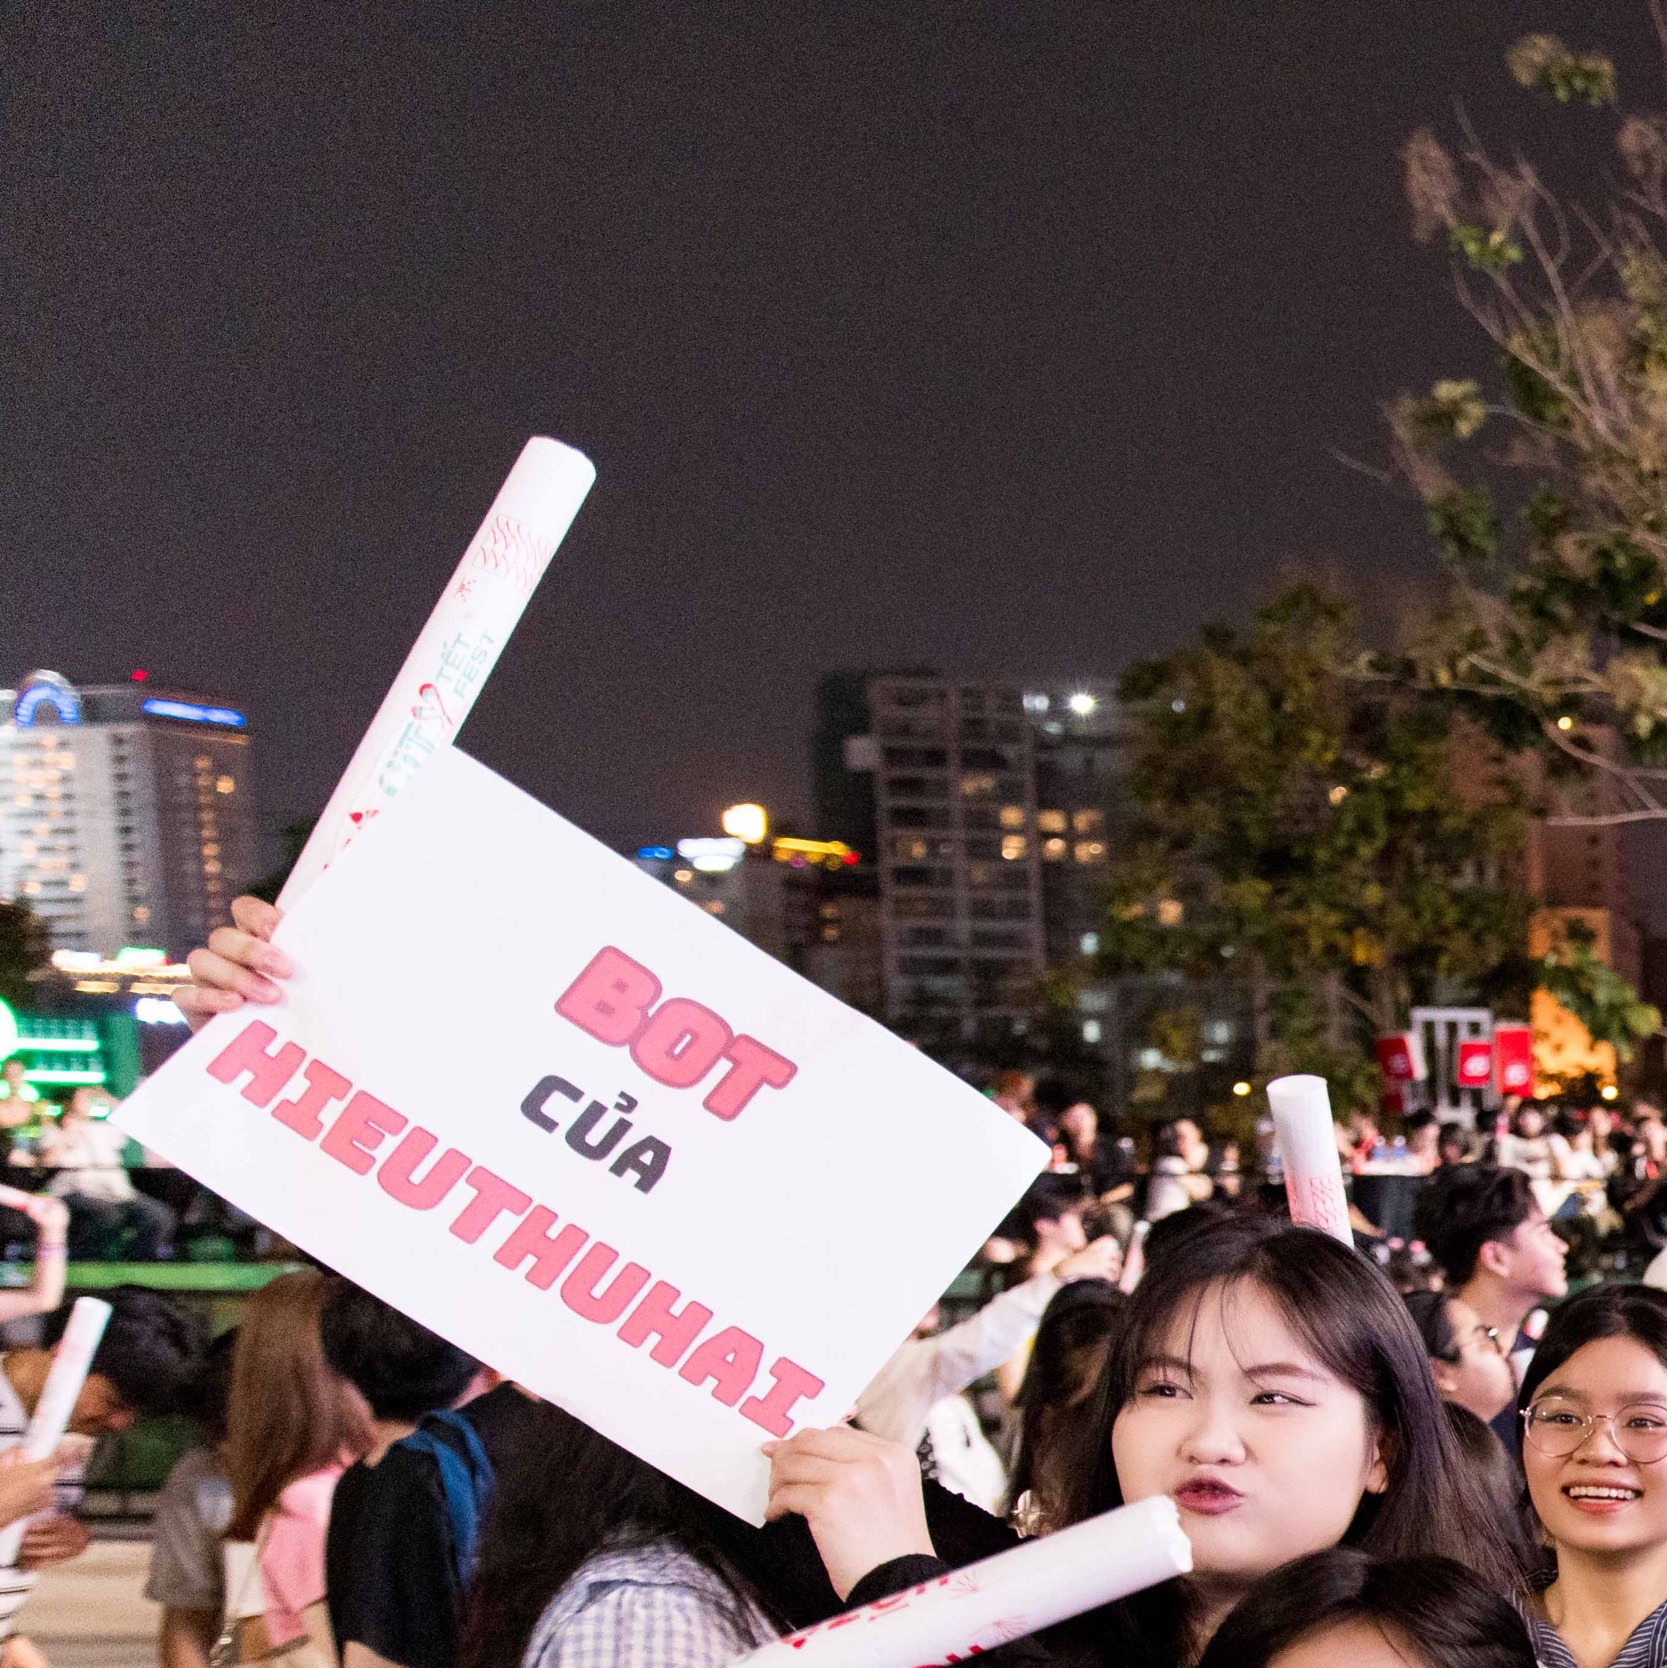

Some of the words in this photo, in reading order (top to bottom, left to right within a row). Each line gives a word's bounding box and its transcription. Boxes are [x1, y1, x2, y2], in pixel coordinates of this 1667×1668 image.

[434, 630, 472, 684] TẾT
[452, 628, 496, 700] FEST
[554, 945, 798, 1122] BOT
[520, 1074, 672, 1194] CỦA
[205, 1019, 825, 1439] HIEUTHUHAI
